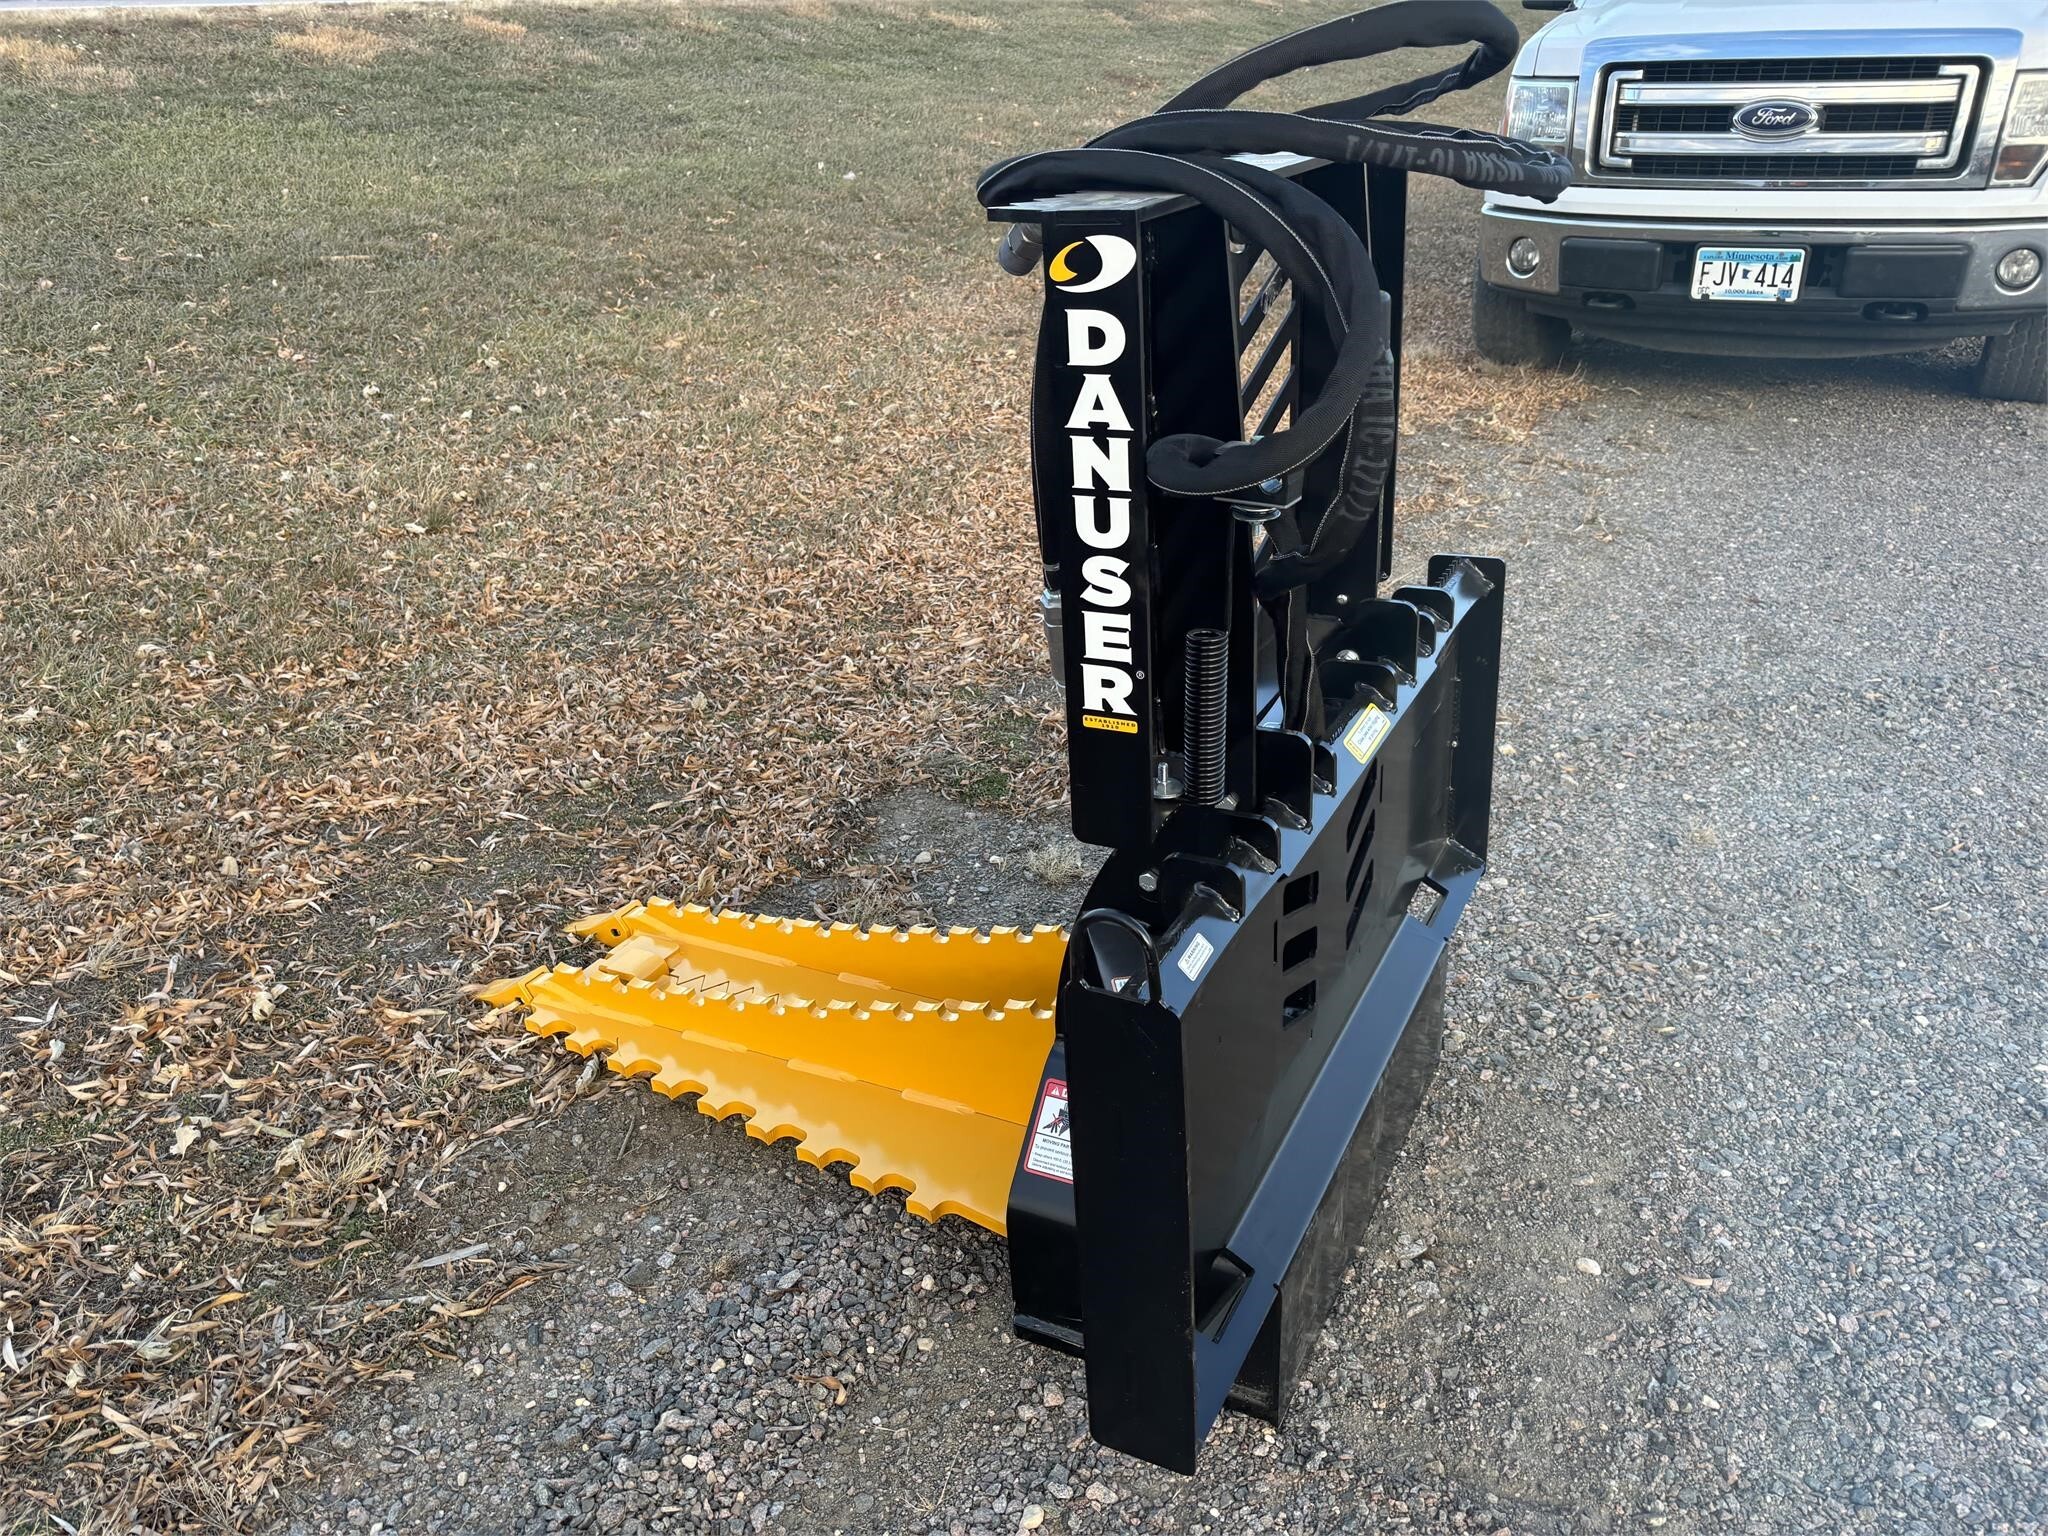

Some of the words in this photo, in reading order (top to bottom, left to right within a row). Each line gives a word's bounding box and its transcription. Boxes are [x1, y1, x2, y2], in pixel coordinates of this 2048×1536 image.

[1751, 107, 1797, 126] Ford
[1463, 149, 1525, 183] MSHA
[1725, 251, 1775, 261] Minnesota
[1699, 261, 1740, 287] FJV
[1754, 262, 1795, 288] 414
[1065, 308, 1138, 716] DANUSER
[1084, 716, 1136, 727] ESTABLISHED
[1042, 1138, 1060, 1147] MOVING
